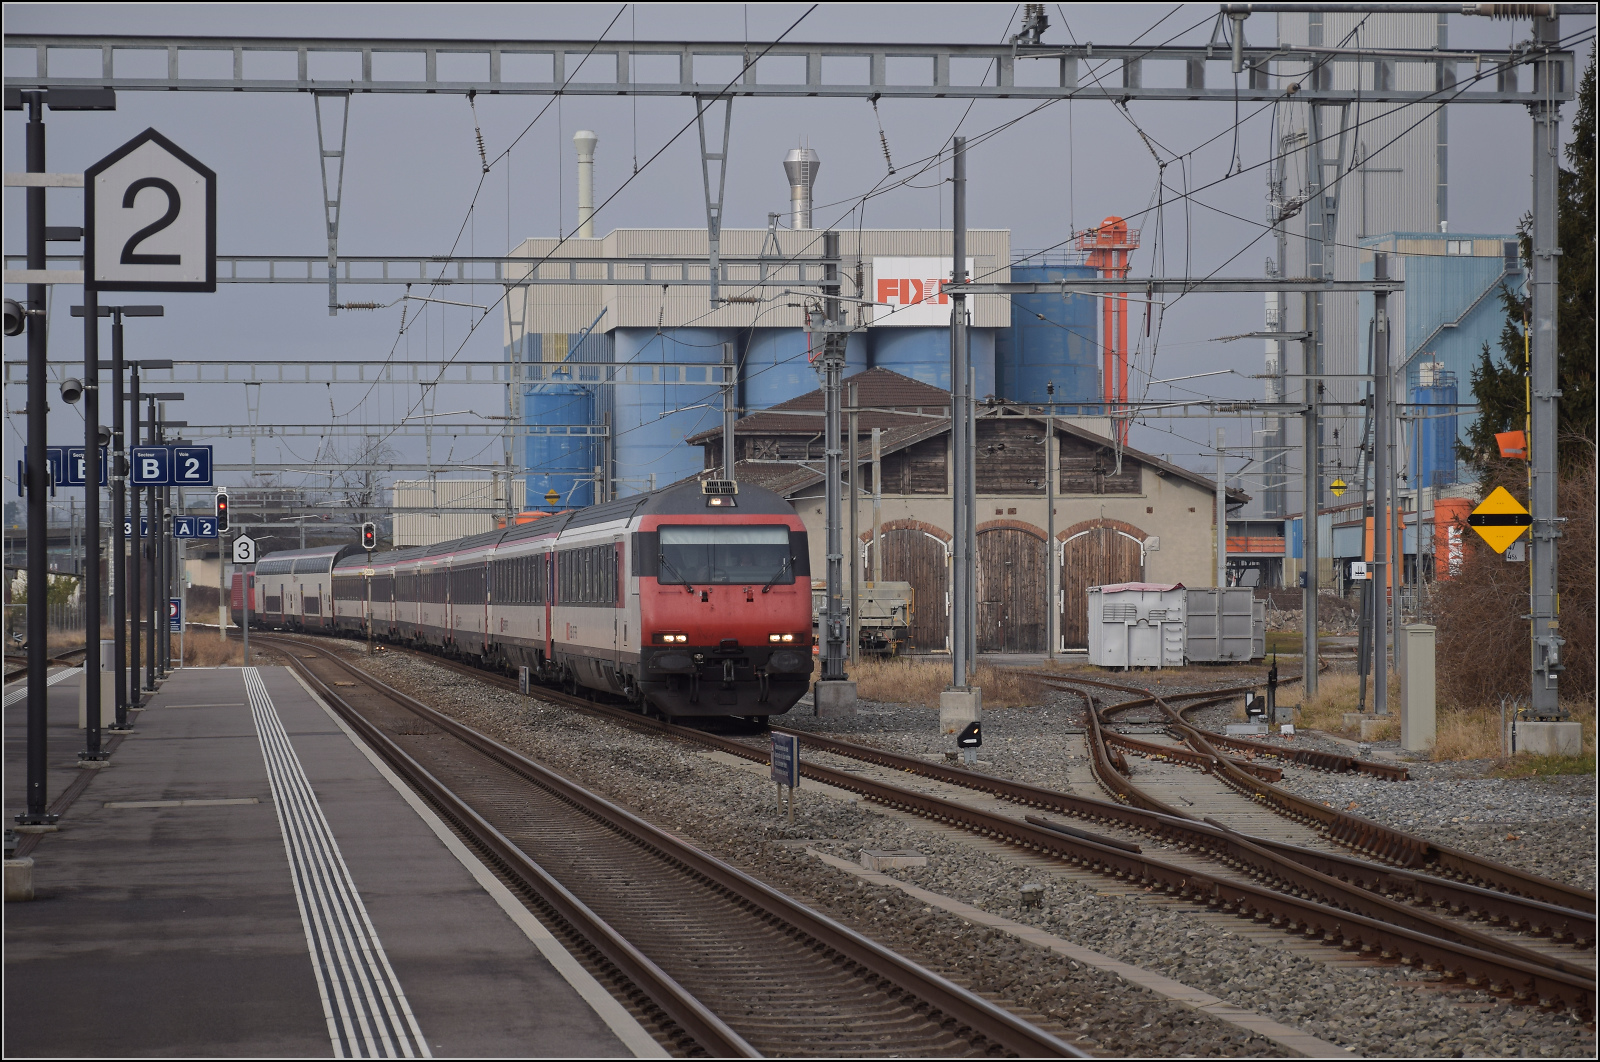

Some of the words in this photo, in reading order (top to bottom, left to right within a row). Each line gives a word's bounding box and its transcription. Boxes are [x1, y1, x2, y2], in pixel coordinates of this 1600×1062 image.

[120, 177, 181, 265] 2
[878, 278, 971, 305] FIXI
[142, 458, 160, 479] B
[184, 457, 200, 479] 2
[124, 522, 132, 535] 3
[179, 522, 190, 535] A
[202, 522, 212, 535] 2
[238, 541, 250, 560] 3
